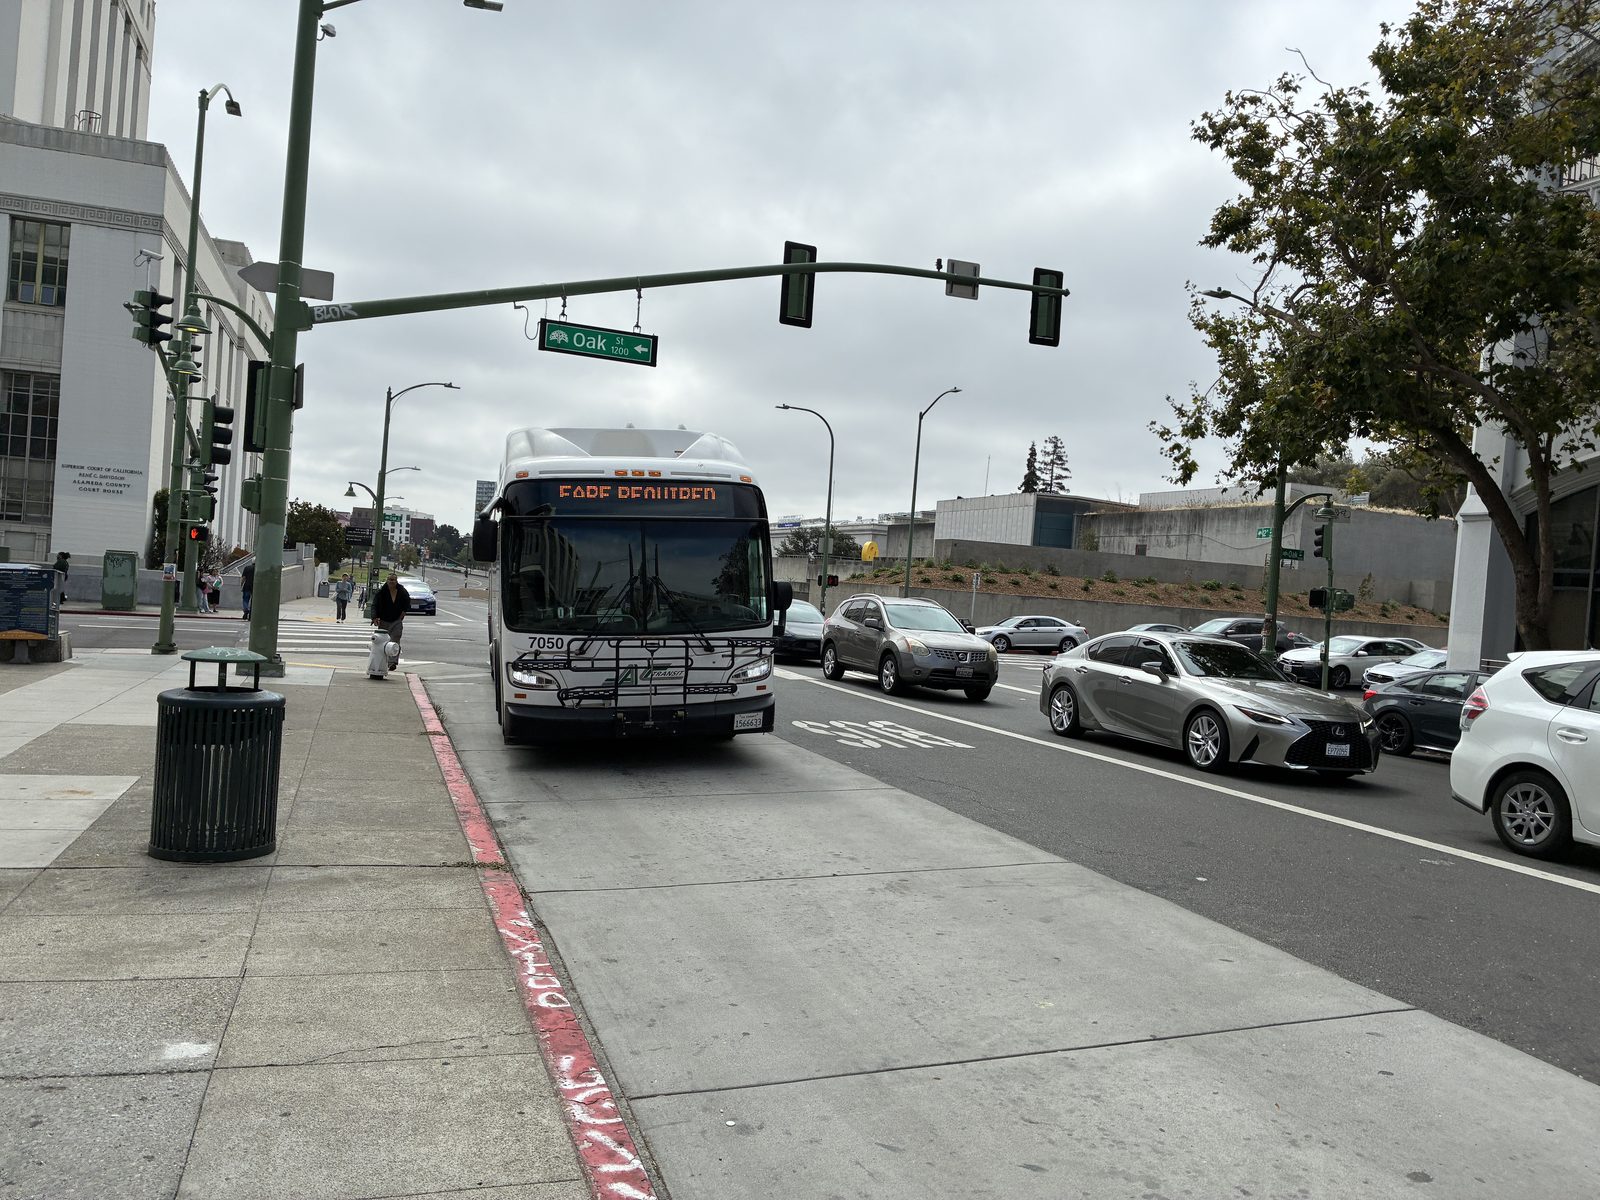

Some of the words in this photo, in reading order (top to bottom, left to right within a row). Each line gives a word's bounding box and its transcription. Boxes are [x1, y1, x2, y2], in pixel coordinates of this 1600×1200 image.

[573, 333, 606, 351] Oak
[616, 337, 624, 345] St
[611, 346, 629, 356] 1200
[528, 636, 564, 650] 7050
